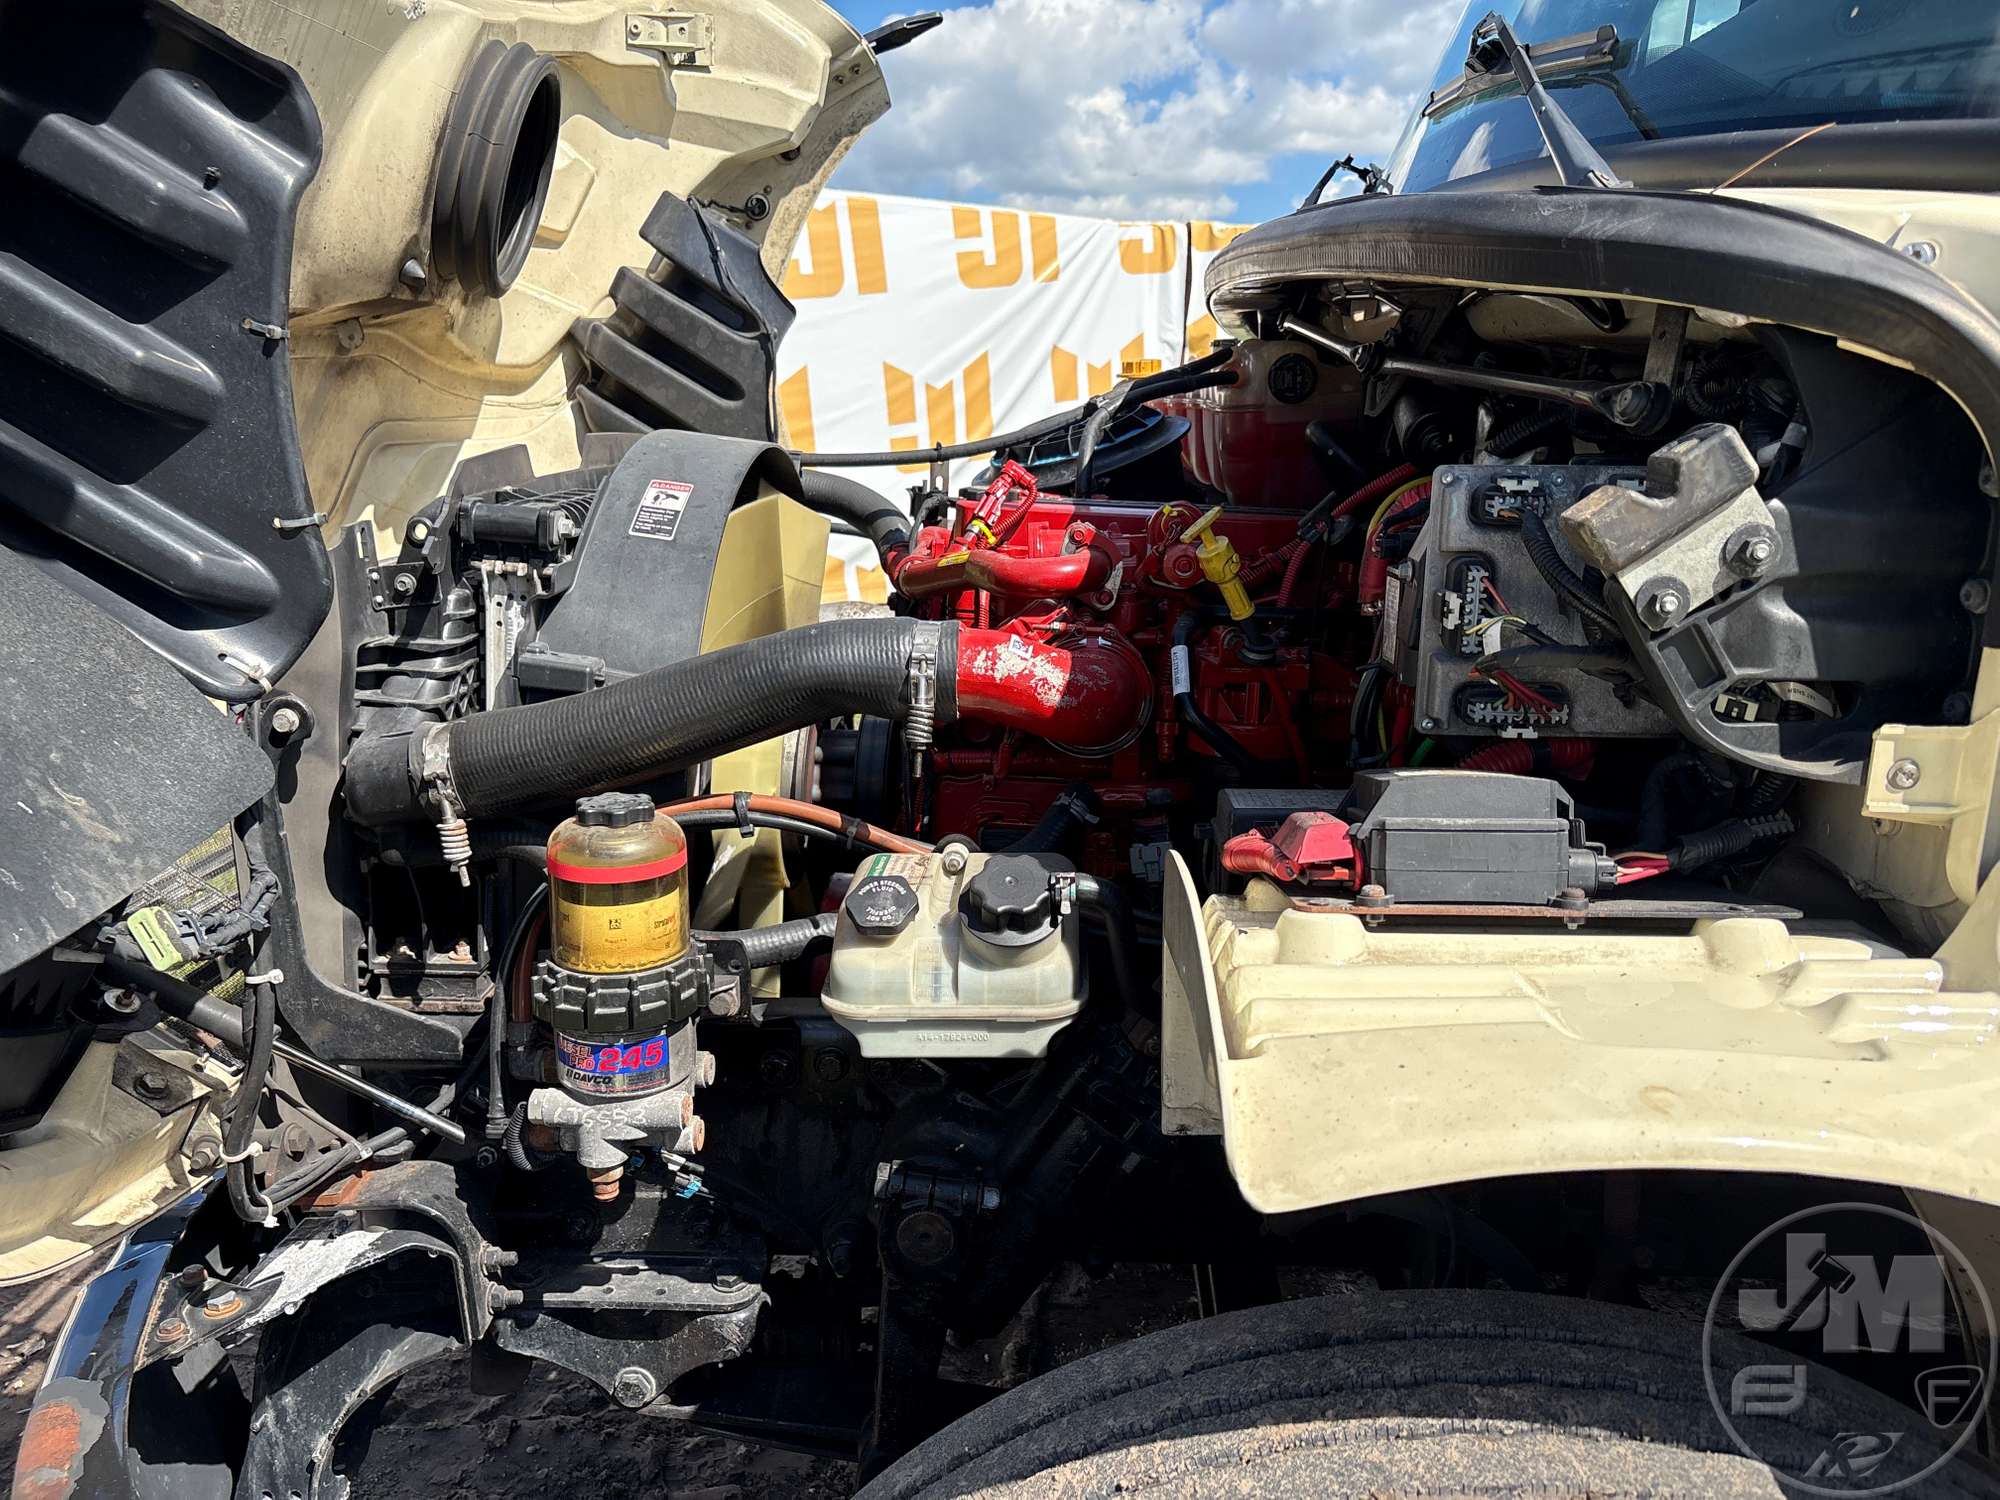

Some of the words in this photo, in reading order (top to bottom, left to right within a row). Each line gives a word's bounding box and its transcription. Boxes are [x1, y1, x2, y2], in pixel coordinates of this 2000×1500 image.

[660, 483, 690, 491] DANGER
[858, 880, 879, 896] POWER
[880, 880, 907, 895] STEERING
[865, 905, 897, 916] OVERFILL
[569, 1053, 596, 1070] PRO
[598, 1040, 664, 1072] 245
[571, 1070, 613, 1085] DAVCO
